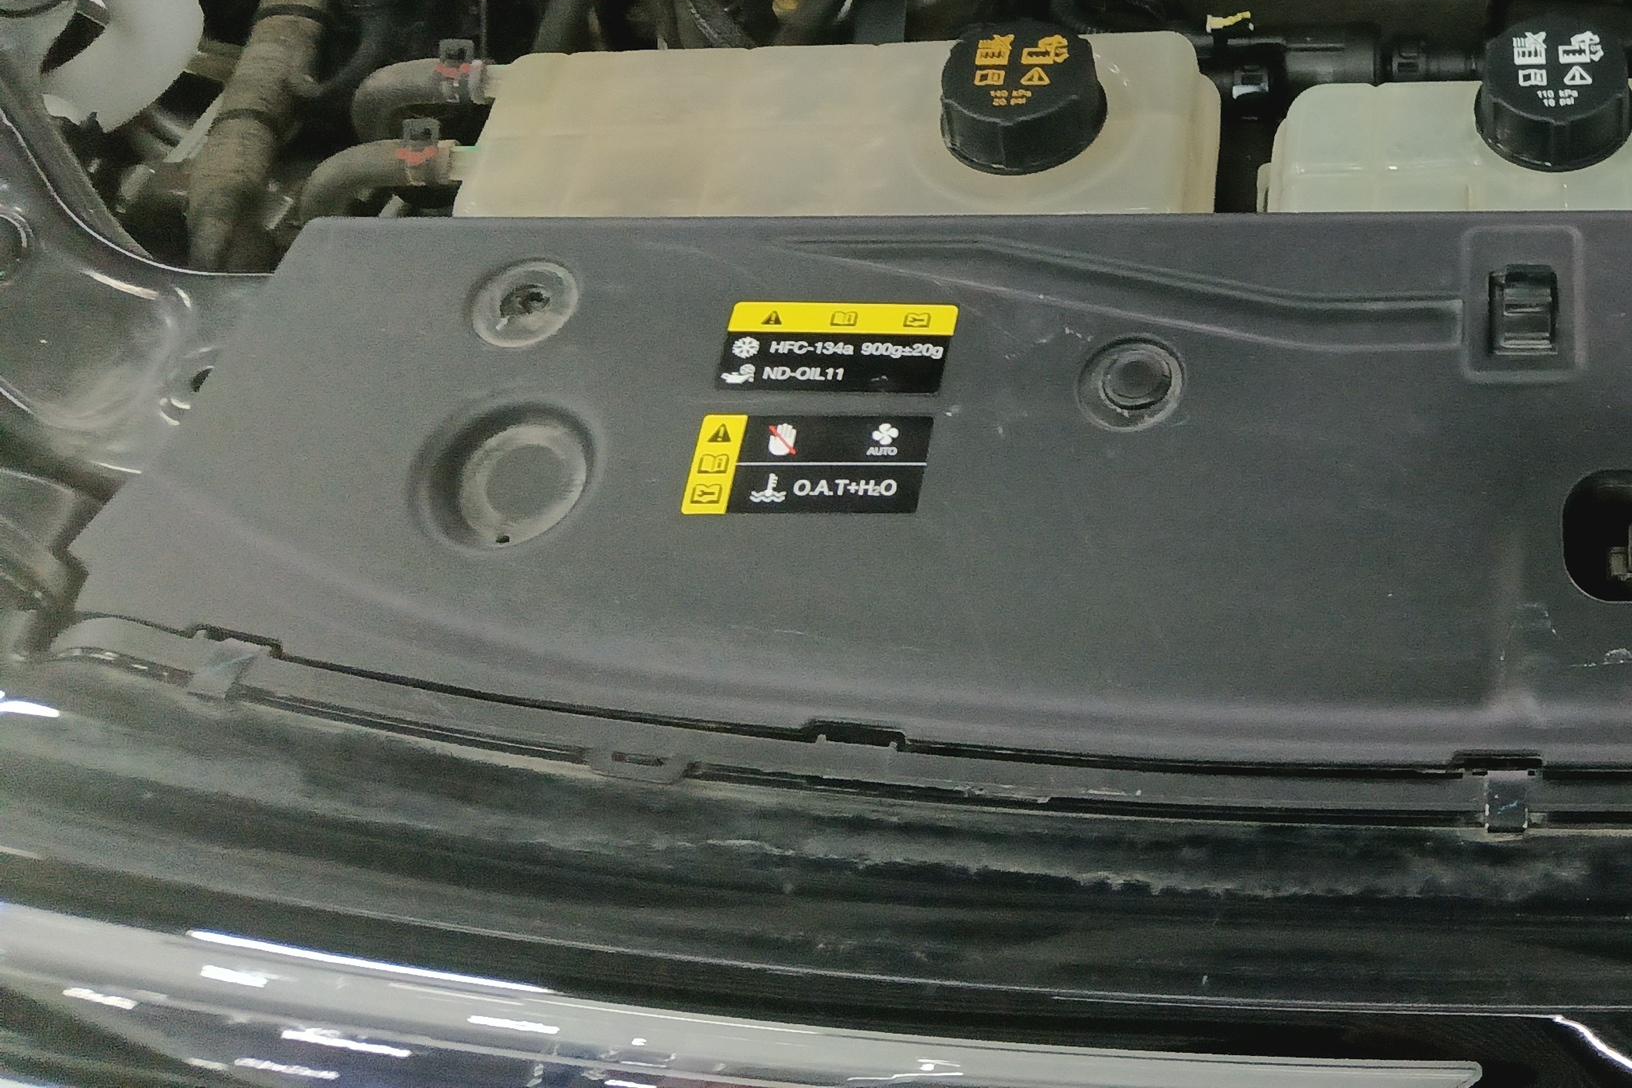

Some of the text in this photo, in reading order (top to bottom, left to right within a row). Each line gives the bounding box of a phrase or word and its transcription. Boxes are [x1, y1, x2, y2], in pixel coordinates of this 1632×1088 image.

[769, 340, 945, 359] HFC-134a 900g±20g
[762, 366, 845, 381] ND-OIL11
[866, 446, 898, 456] AUTO
